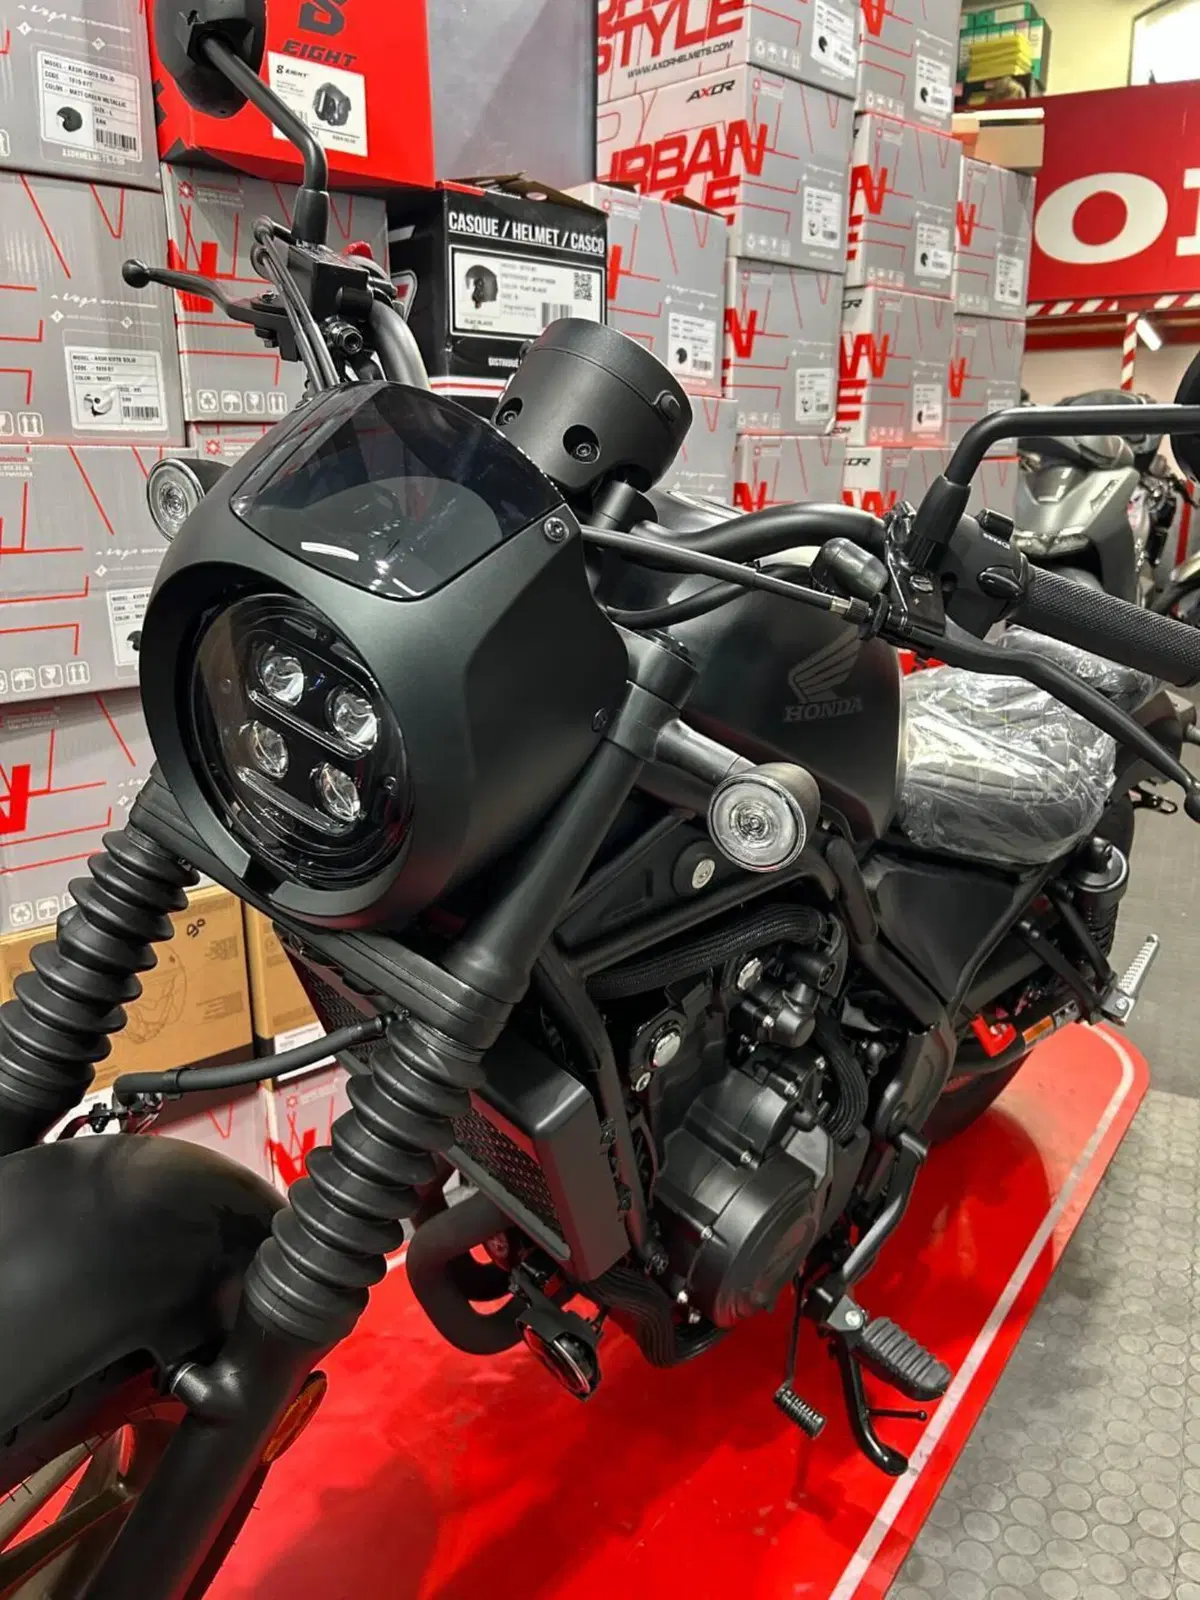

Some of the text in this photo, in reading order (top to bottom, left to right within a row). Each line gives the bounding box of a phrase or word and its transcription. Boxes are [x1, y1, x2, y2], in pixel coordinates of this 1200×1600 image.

[282, 38, 358, 68] EIGHT
[627, 40, 735, 79] WWW.AXORHELMETS.COM
[285, 68, 308, 78] EIGHT
[685, 80, 736, 103] AXOR
[448, 211, 500, 237] CASQUE
[501, 220, 510, 237] /
[512, 222, 560, 247] HELMET
[571, 232, 605, 254] CASCO
[783, 696, 863, 722] HONDA
